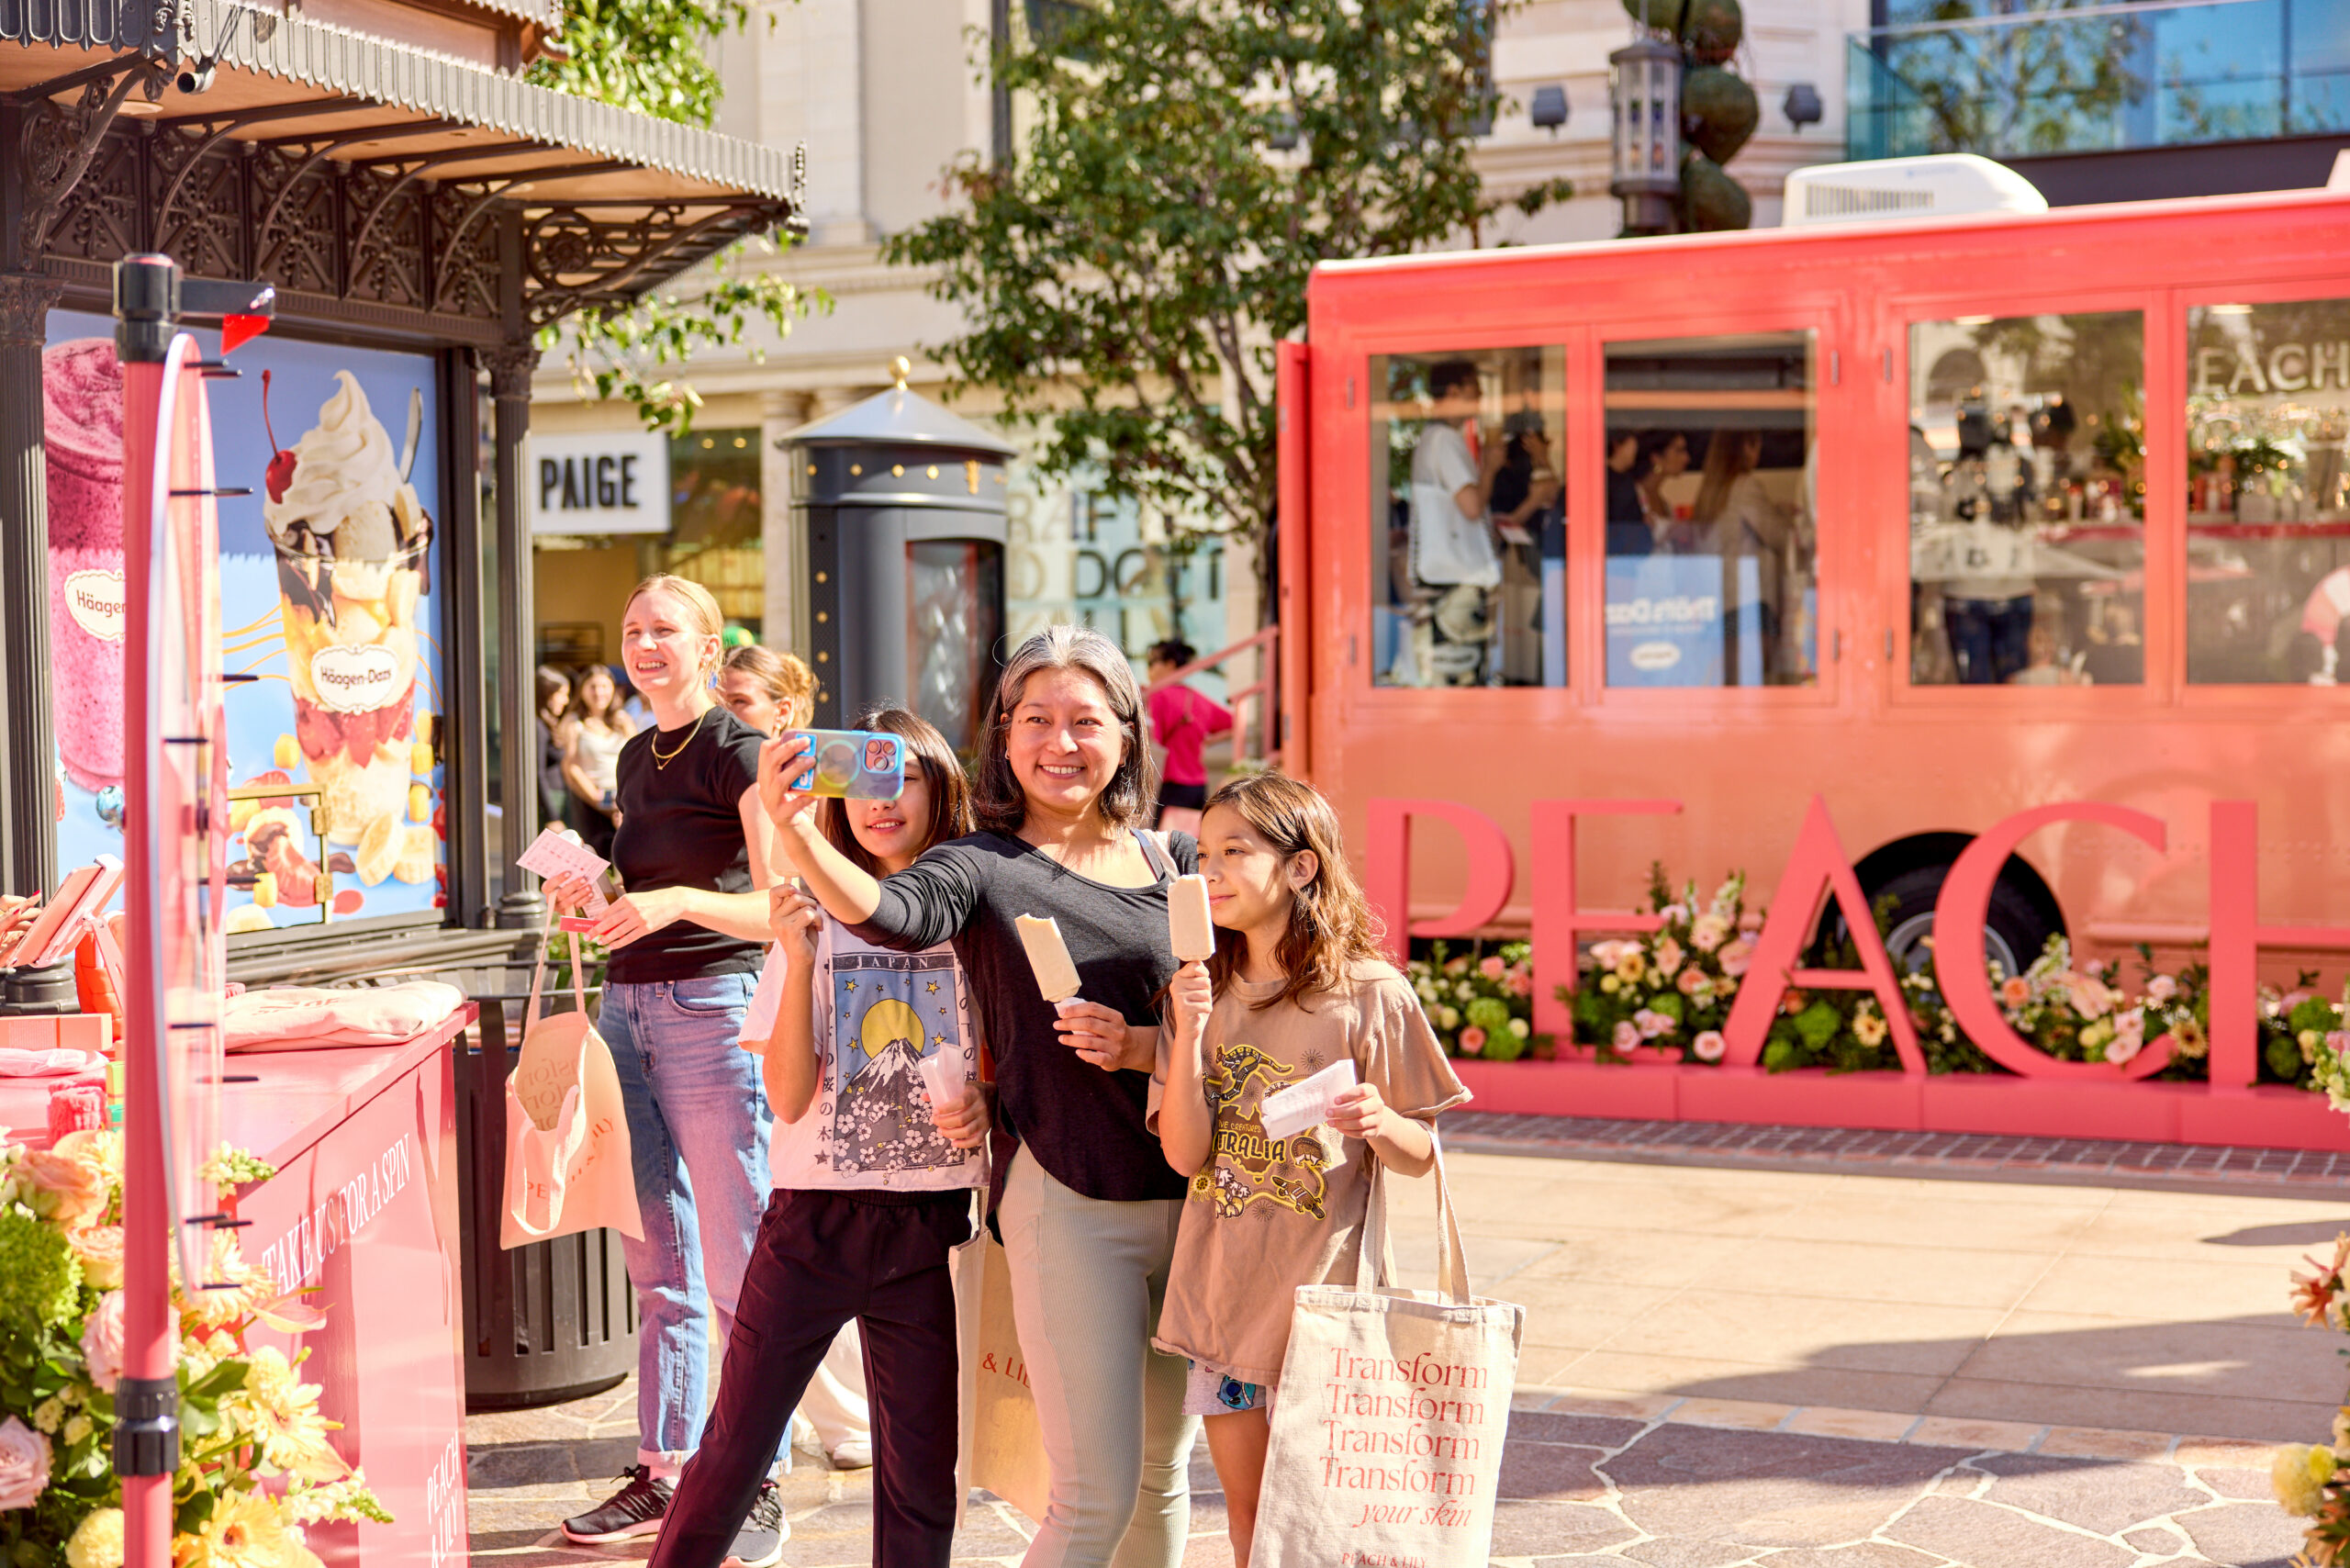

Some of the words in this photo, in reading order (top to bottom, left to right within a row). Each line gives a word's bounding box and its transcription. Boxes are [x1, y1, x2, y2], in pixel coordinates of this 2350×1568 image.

[2195, 342, 2350, 394] EACH
[540, 455, 639, 510] PAIGE
[856, 957, 929, 969] JAPAN
[1214, 1129, 1286, 1163] TRALIA
[1230, 1122, 1262, 1134] CREATURES
[263, 1216, 313, 1297] TAKE
[314, 1198, 336, 1263] US
[338, 1172, 370, 1246] FOR
[371, 1161, 382, 1217] A
[382, 1133, 410, 1204] SPIN
[1005, 1357, 1031, 1389] LIL
[1331, 1347, 1488, 1389] Transform
[1326, 1383, 1484, 1424] Transform
[1323, 1419, 1480, 1460] Transform
[427, 1430, 459, 1526] PEACH
[1319, 1456, 1475, 1495] Transform
[440, 1489, 458, 1562] LILY
[1351, 1504, 1419, 1529] your
[1420, 1499, 1472, 1528] skin
[1341, 1552, 1387, 1566] PEACH
[1391, 1557, 1399, 1566] &
[1403, 1556, 1428, 1568] LILY
